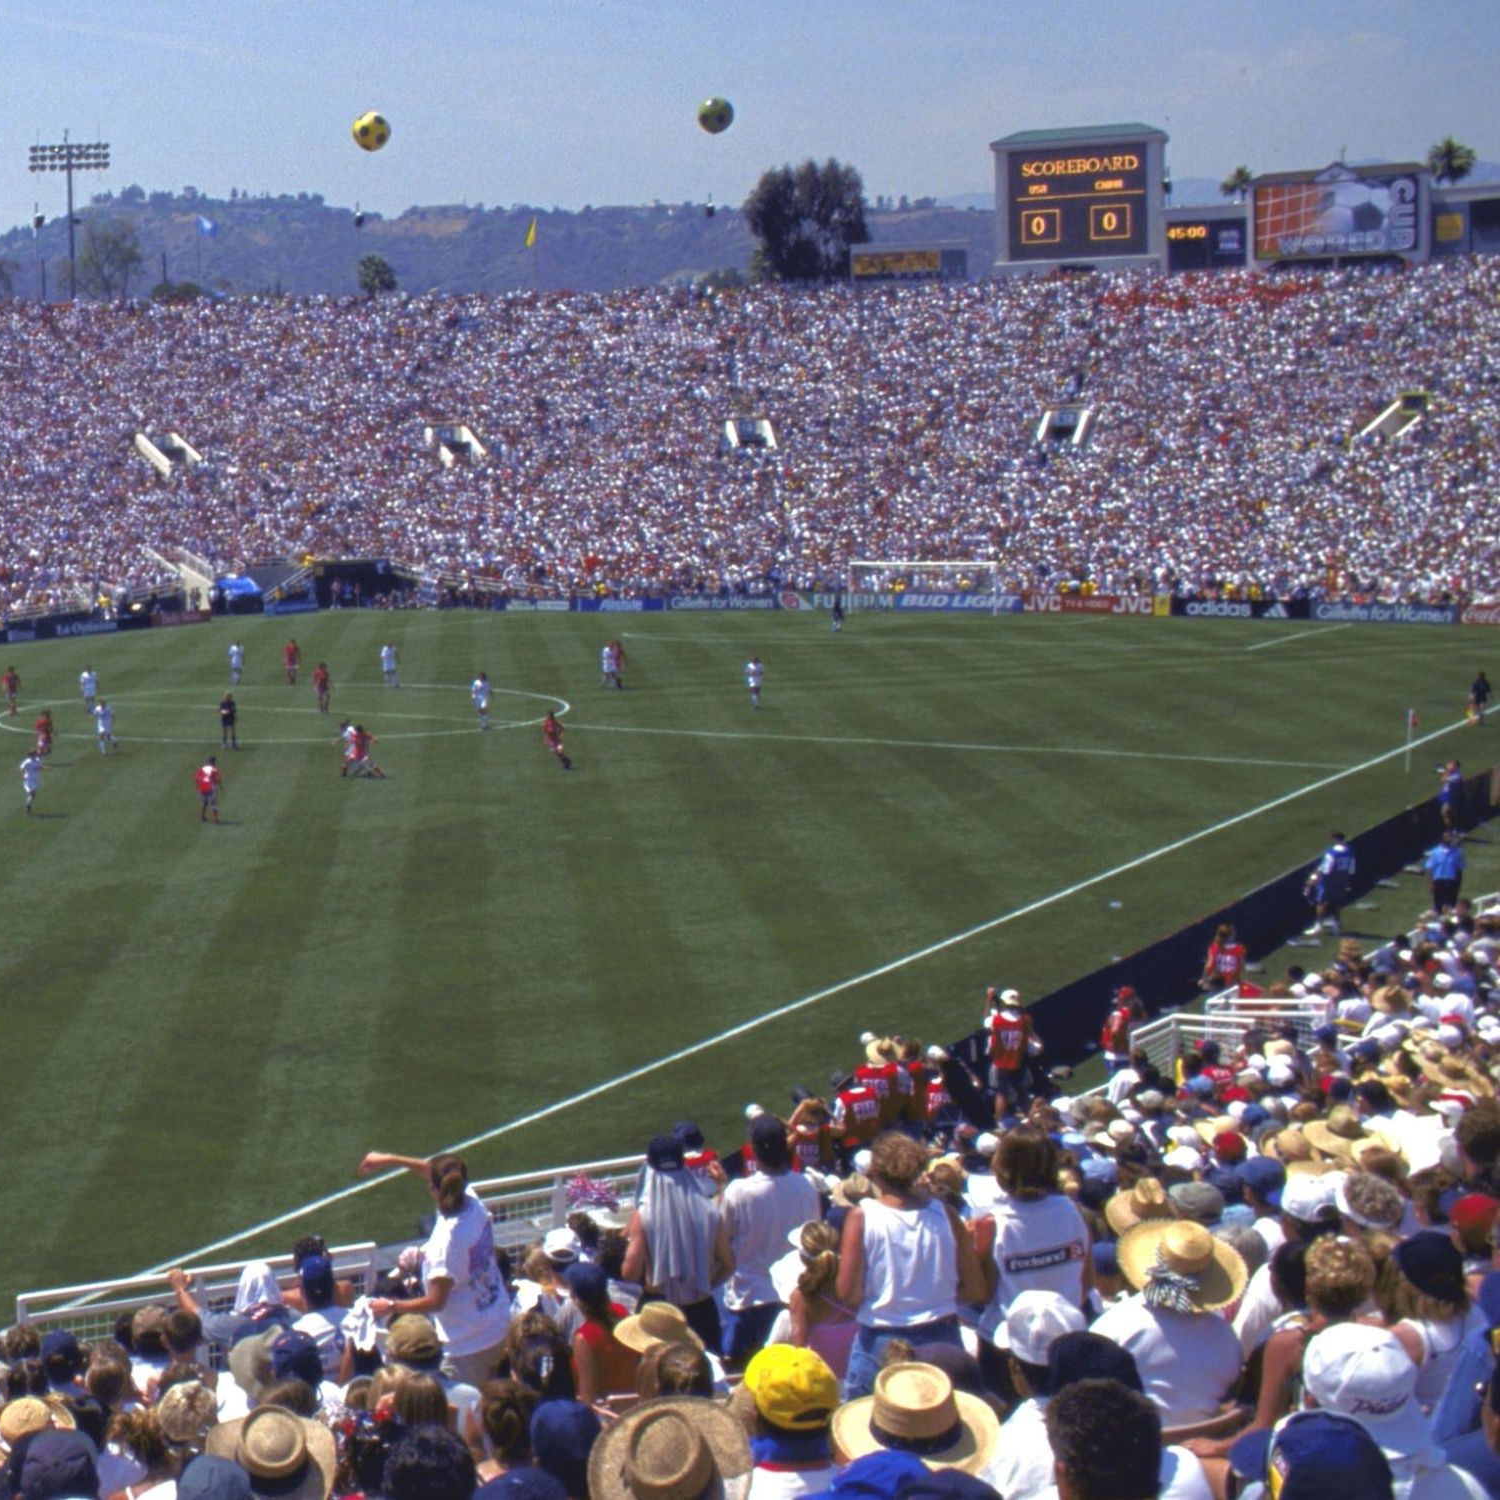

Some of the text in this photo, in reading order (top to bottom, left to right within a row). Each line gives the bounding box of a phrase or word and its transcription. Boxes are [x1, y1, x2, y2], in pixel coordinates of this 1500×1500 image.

[1021, 155, 1138, 177] SCOREBOARD
[1028, 178, 1124, 195] USA CHINA
[1389, 179, 1415, 250] CUP
[1031, 212, 1117, 236] 0 0
[1167, 225, 1207, 239] 45:00
[1277, 230, 1387, 255] WORLD
[710, 596, 727, 609] for
[729, 595, 773, 609] Women
[901, 594, 1019, 609] BUD LIGHT
[1024, 595, 1061, 611] JVC
[1112, 597, 1152, 613] JVC
[1186, 600, 1250, 617] adidas
[1316, 603, 1454, 623] Gillette for Women
